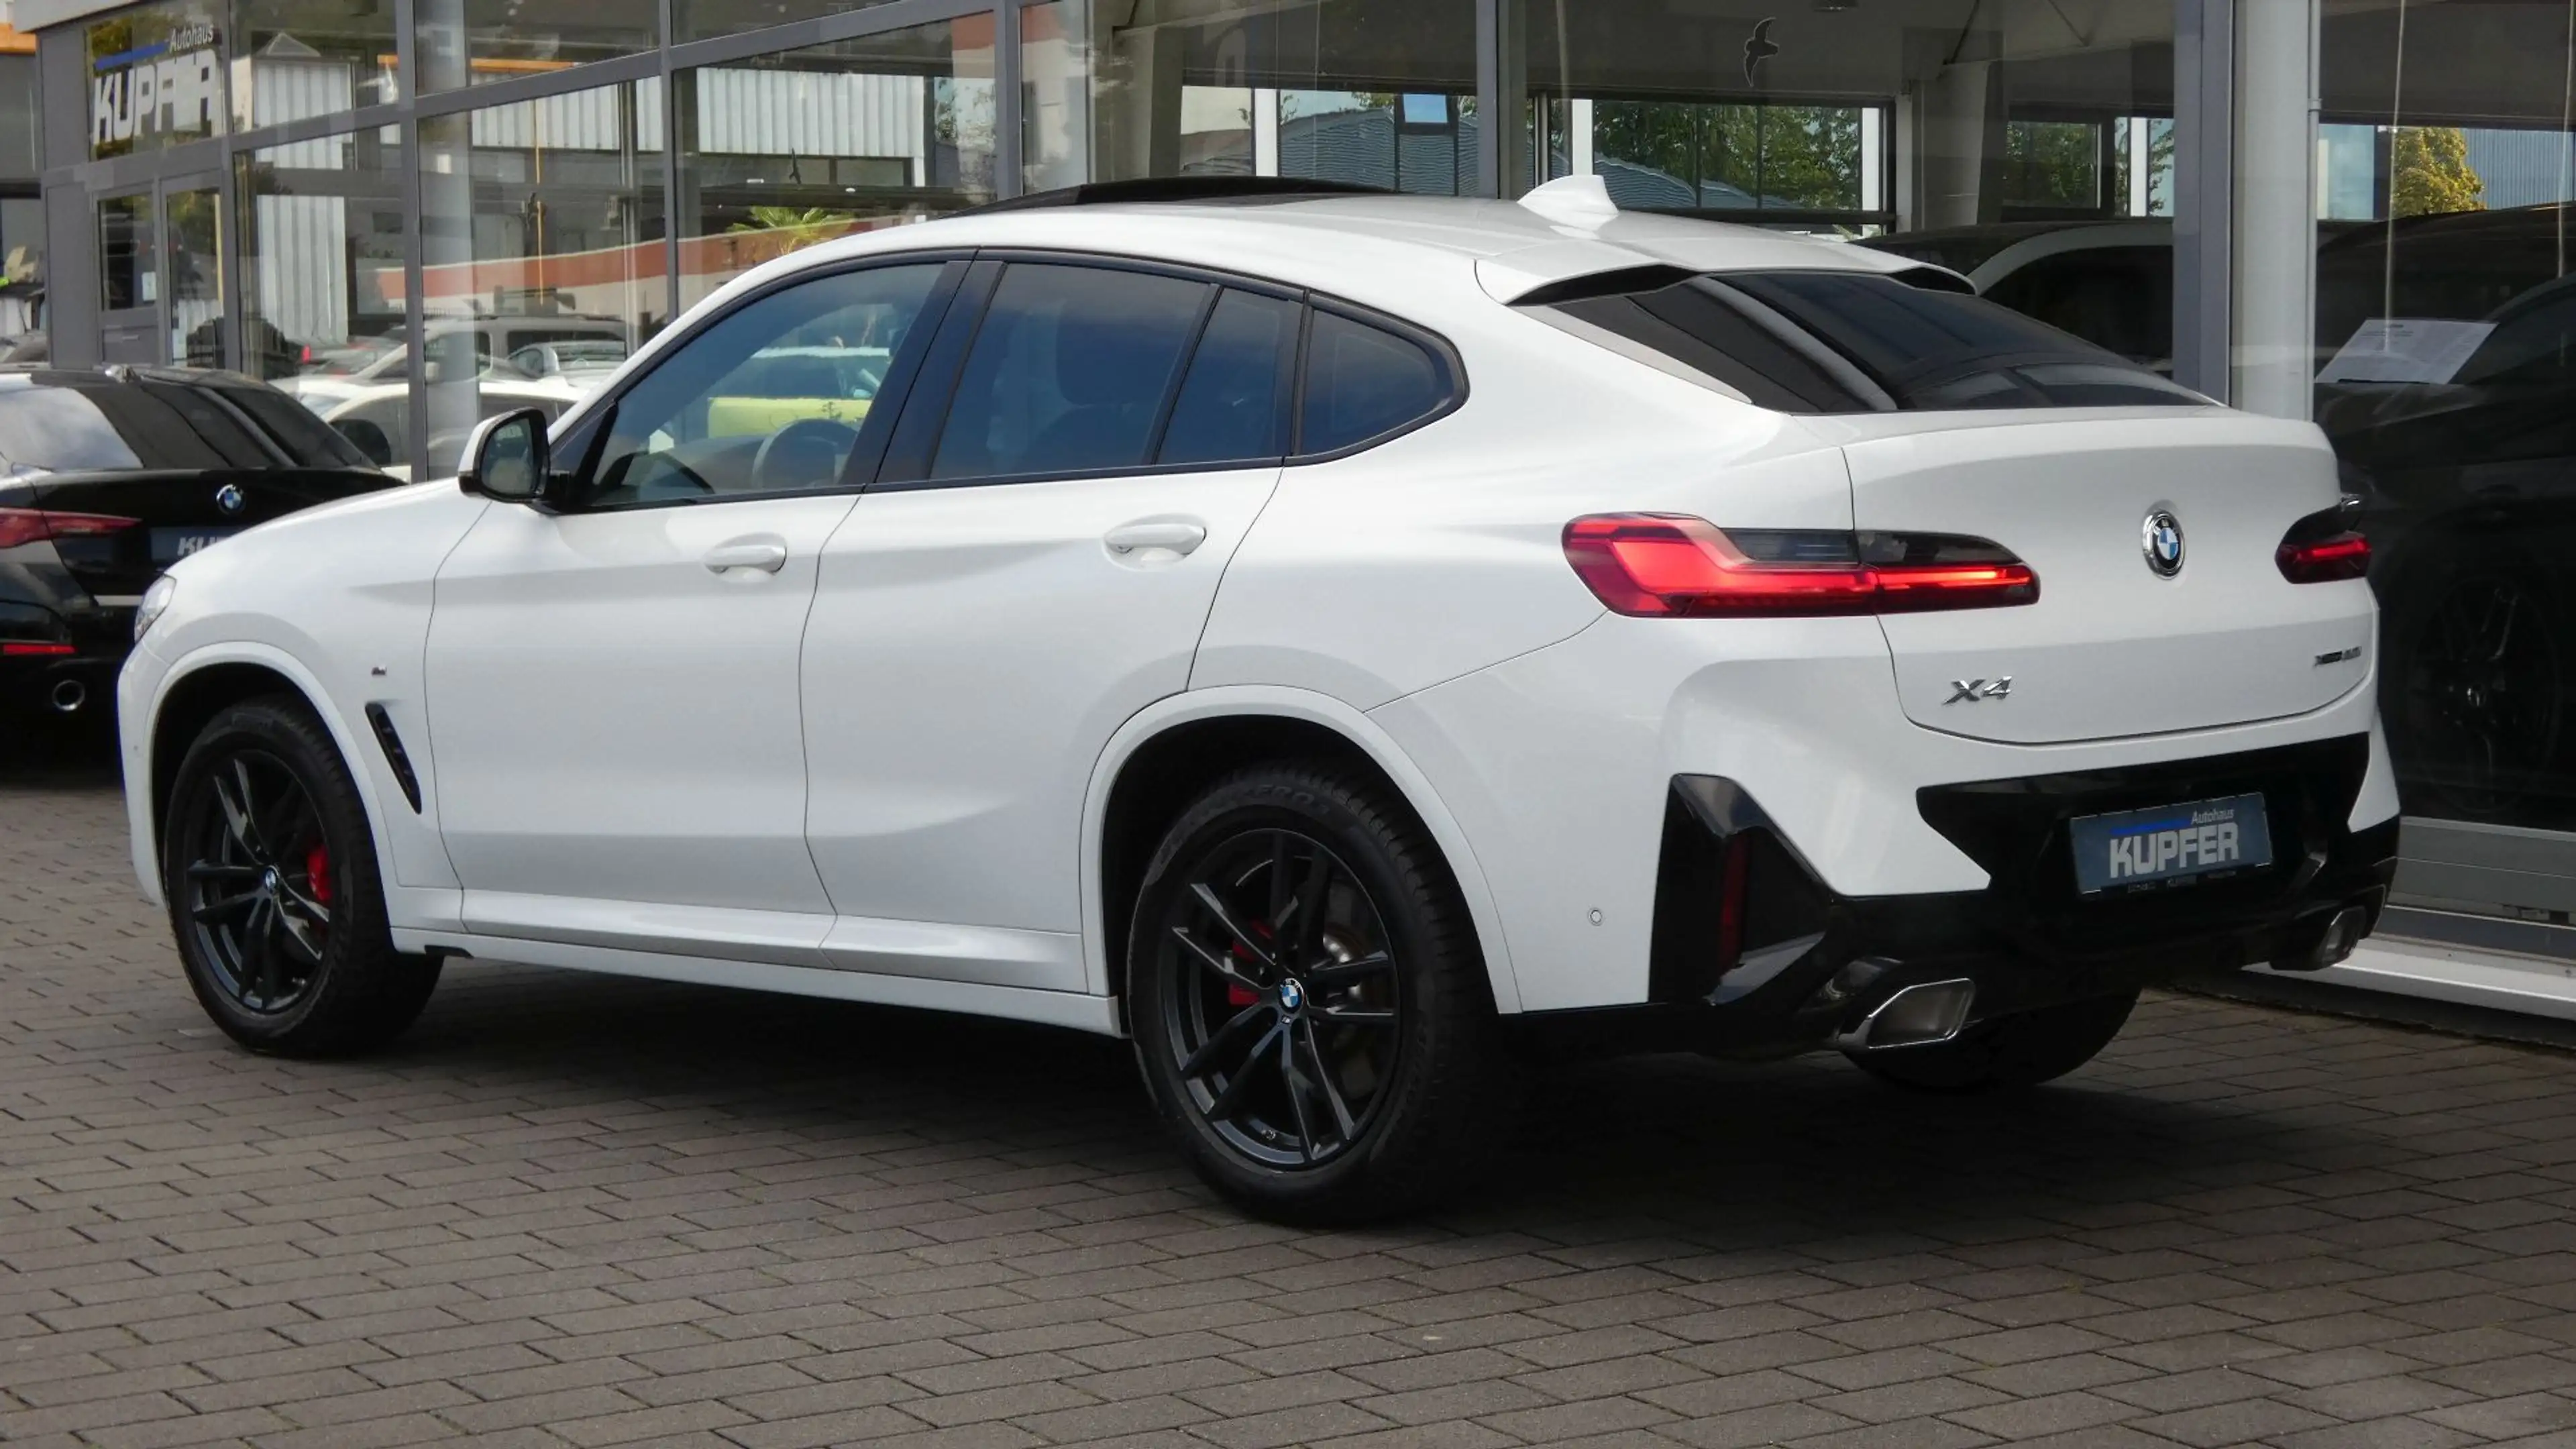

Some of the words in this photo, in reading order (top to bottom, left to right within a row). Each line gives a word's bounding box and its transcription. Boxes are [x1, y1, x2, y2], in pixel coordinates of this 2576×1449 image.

[168, 24, 214, 52] Autohaus
[1942, 676, 2012, 706] X4
[2190, 808, 2235, 825] Autohaus
[2110, 822, 2239, 878] KUPFER
